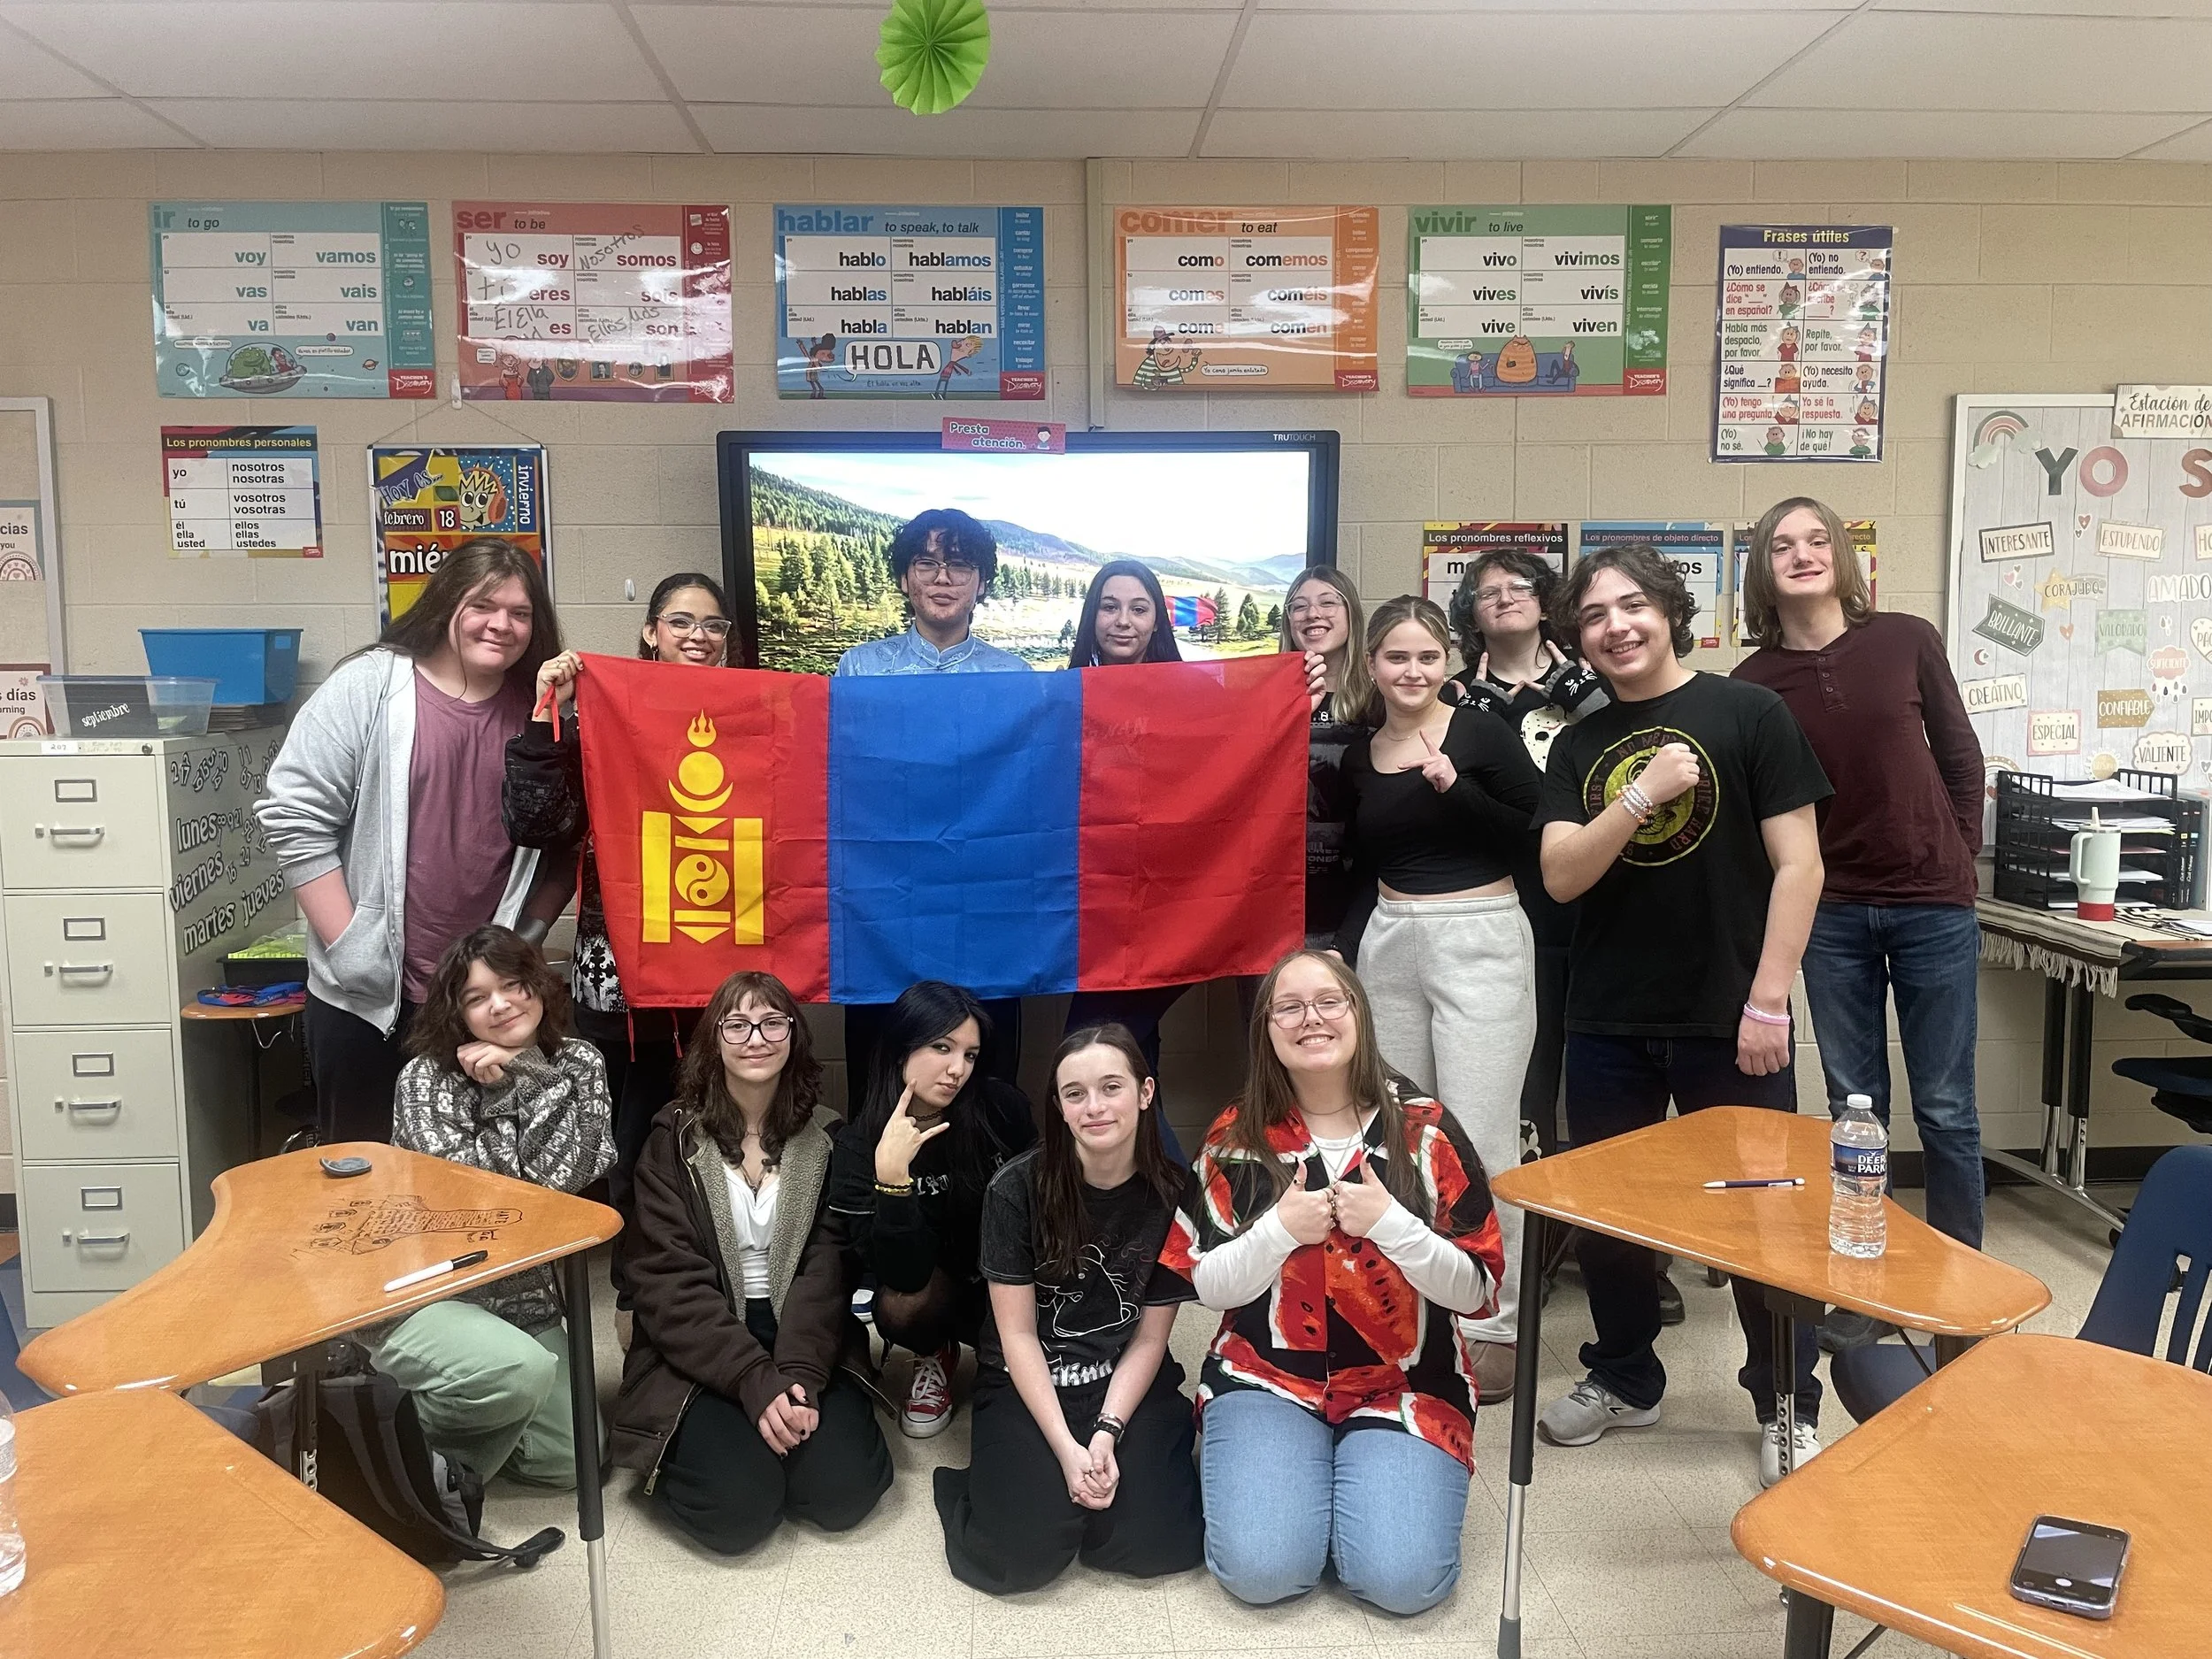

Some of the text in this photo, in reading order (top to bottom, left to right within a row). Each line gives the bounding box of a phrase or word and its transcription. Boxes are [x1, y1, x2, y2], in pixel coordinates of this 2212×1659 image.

[154, 205, 219, 230] ir to go
[457, 210, 546, 230] ser to be
[778, 210, 979, 235] hablar to speak, to talk
[1120, 211, 1278, 234] comer to eat
[1414, 211, 1524, 233] vivir to live
[1763, 228, 1849, 243] Frases útiles
[234, 251, 266, 266] voy
[316, 250, 377, 264] vamos
[537, 253, 570, 268] soy
[617, 254, 677, 267] somos
[839, 252, 887, 267] hablo
[909, 252, 992, 267] hablamos
[1178, 254, 1225, 267] como
[1246, 254, 1328, 267] comemos
[1483, 252, 1517, 266] vivo
[1555, 250, 1620, 266] vivimos
[1809, 252, 1826, 264] (Yo)
[1727, 265, 1784, 276] (Yo) entiendo.
[1809, 265, 1847, 275] entiendo.
[235, 286, 267, 298] vas
[340, 283, 377, 298] vais
[831, 287, 887, 301] hablas
[932, 286, 992, 302] habláis
[1267, 285, 1327, 302] coméis
[1472, 286, 1517, 301] vives
[1580, 285, 1619, 300] vivís
[1726, 282, 1754, 293] ¿Cómo
[529, 288, 571, 301] eres
[1169, 289, 1225, 302] comes
[1726, 294, 1742, 303] dice
[1725, 305, 1773, 317] en español?
[248, 319, 269, 332] va
[346, 319, 379, 332] van
[549, 323, 572, 334] es
[645, 324, 679, 335] son
[841, 319, 887, 334] habla
[935, 319, 992, 334] hablan
[1178, 322, 1225, 335] come
[1271, 321, 1327, 334] comen
[1481, 319, 1516, 334] vive
[1572, 319, 1617, 333] viven
[1725, 323, 1768, 333] Habla más
[1806, 328, 1832, 340] Repite,
[1724, 336, 1763, 346] despacio,
[1805, 342, 1843, 353] por favor.
[851, 344, 935, 370] HOLA
[1724, 348, 1762, 358] por favor.
[1724, 365, 1744, 375] ¿Qué
[1802, 365, 1853, 378] (Yo) necesito
[1724, 378, 1755, 388] significa
[1802, 378, 1829, 389] ayuda.
[1722, 396, 1763, 409] (Yo) tengo
[1802, 396, 1834, 406] Yo sé la
[2129, 393, 2212, 411] Estación de
[1722, 410, 1736, 419] una
[1801, 410, 1843, 421] respuesta.
[949, 422, 989, 434] Presta
[1721, 428, 1737, 440] (Yo)
[1818, 428, 1833, 441] hay
[166, 437, 312, 449] Los pronombres personales
[972, 437, 1026, 449] atención.
[1800, 441, 1832, 453] de qué!
[173, 468, 187, 479] yo
[232, 463, 285, 472] nosotros
[232, 474, 285, 483] nosotras
[234, 494, 286, 503] vosotros
[518, 465, 533, 525] invierno
[174, 499, 186, 509] tú
[234, 505, 286, 514] vosotras
[175, 521, 185, 530] él
[234, 521, 259, 530] ellos
[383, 511, 456, 528] febrero 18
[177, 539, 205, 548] usted
[236, 539, 277, 548] ustedes
[1429, 533, 1563, 545] Los pronombres reflexivos
[1601, 533, 1651, 545] pronombres
[1653, 533, 1662, 541] de
[1663, 533, 1689, 545] objeto
[1691, 533, 1719, 542] directo
[1985, 532, 2050, 555] INTERESANTE
[2101, 533, 2160, 552] ESTUPENDO
[2045, 581, 2100, 598] CORAJUDO
[2149, 573, 2212, 601] AMADO
[1987, 610, 2039, 647] BRILLANTE
[2099, 621, 2144, 637] VALORADO
[6, 688, 36, 701] días
[1969, 682, 2023, 706] CREATIVO
[2098, 700, 2151, 717] CONFIABLE
[81, 703, 131, 728] septiembre
[2032, 725, 2078, 740] ESPECIAL
[2139, 746, 2187, 764] VALIENTE
[176, 813, 217, 855] lunes
[168, 850, 224, 913] viernes
[242, 868, 285, 927] jueves
[183, 902, 236, 956] martes
[1857, 1155, 1886, 1164] DEER
[1857, 1164, 1886, 1174] PARK
